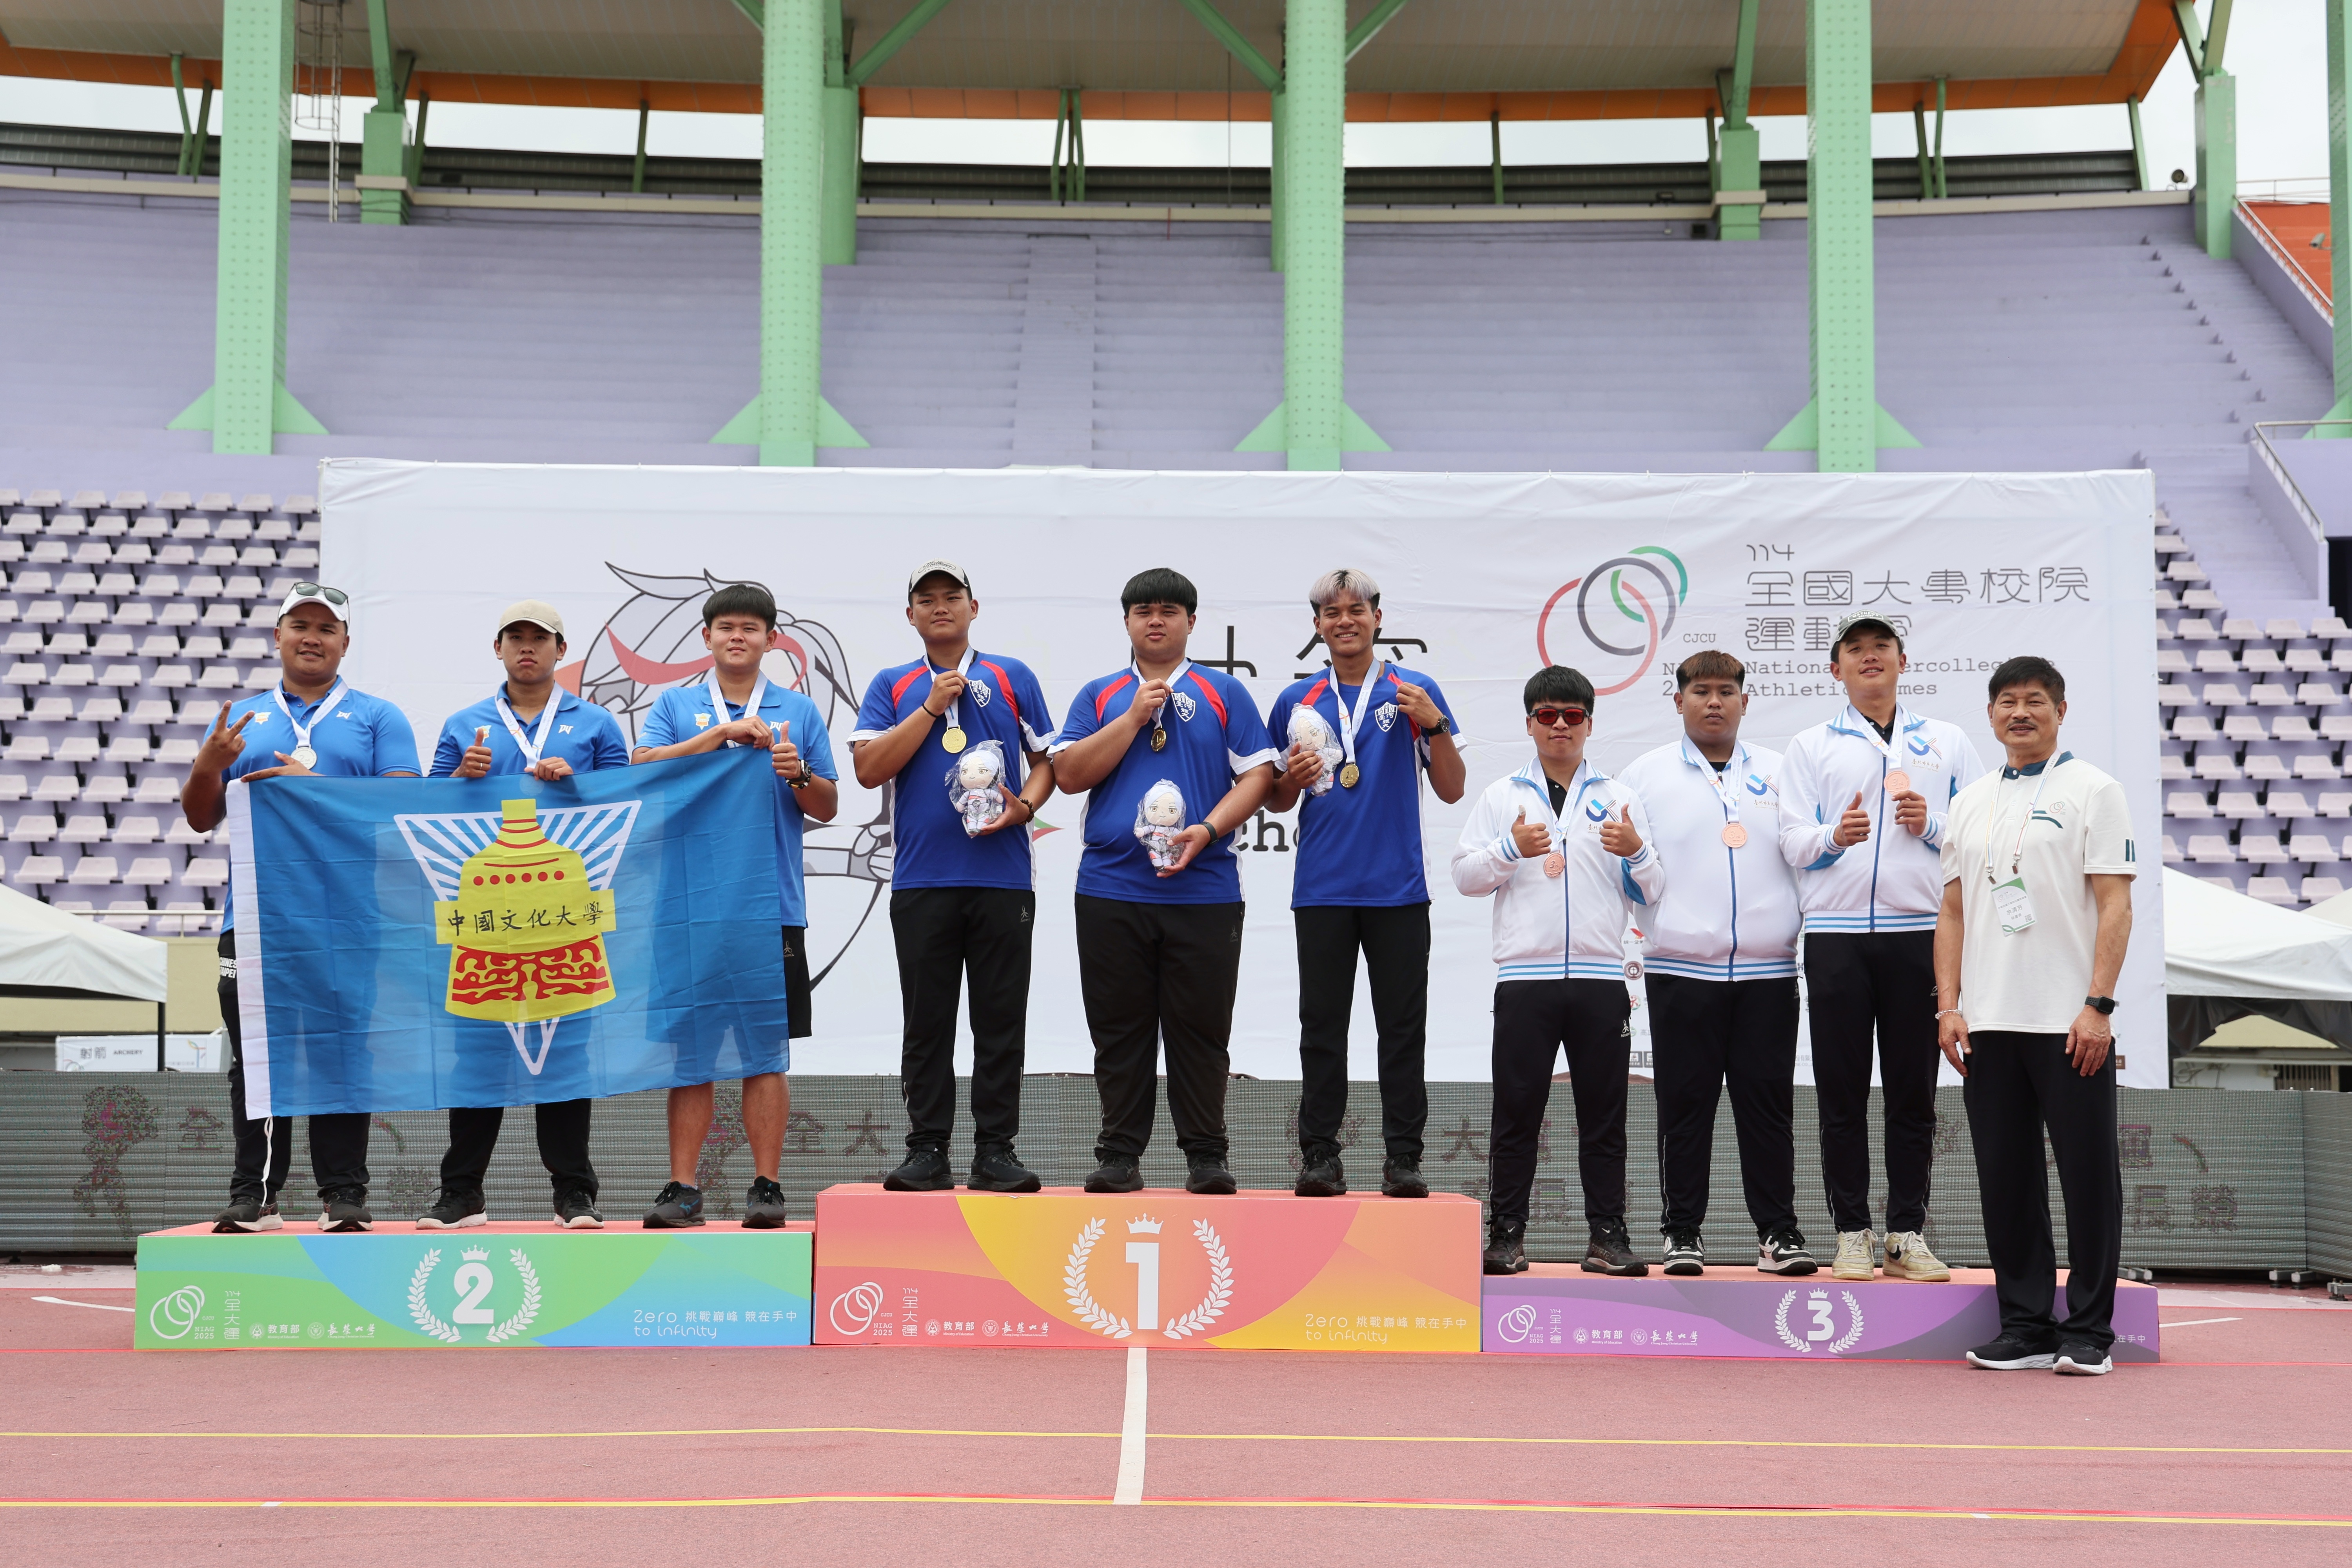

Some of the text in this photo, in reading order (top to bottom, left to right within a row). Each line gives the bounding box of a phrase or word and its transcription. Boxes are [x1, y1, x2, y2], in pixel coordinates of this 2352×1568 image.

[1746, 544, 1795, 561] 114
[1683, 633, 1716, 643] CJCU
[1746, 662, 1831, 674] Nationa
[1898, 683, 1937, 695] mes
[2006, 904, 2022, 915] 余清芳
[448, 901, 603, 936] 中國文化大學
[80, 1047, 107, 1059] 射箭
[1125, 1242, 1159, 1330] 1
[453, 1262, 494, 1324] 2
[224, 1299, 240, 1339] 全大運
[634, 1310, 797, 1323] Zero 挑戰巔峰 競在手中
[902, 1296, 918, 1336] 全大運
[1305, 1314, 1466, 1329] Zero 挑戰巔峰 競在手中
[1808, 1300, 1834, 1341] 3
[268, 1324, 300, 1334] 教育部
[327, 1323, 375, 1335] 長榮大學
[634, 1324, 717, 1339] to infinity
[943, 1321, 975, 1331] 教育部
[1002, 1321, 1049, 1334] 長榮大學
[1550, 1315, 1561, 1344] 全大運
[1305, 1329, 1387, 1344] to infinity
[1592, 1330, 1622, 1339] 教育部
[1650, 1330, 1698, 1343] 長榮大學
[2114, 1334, 2145, 1343] 在手中
